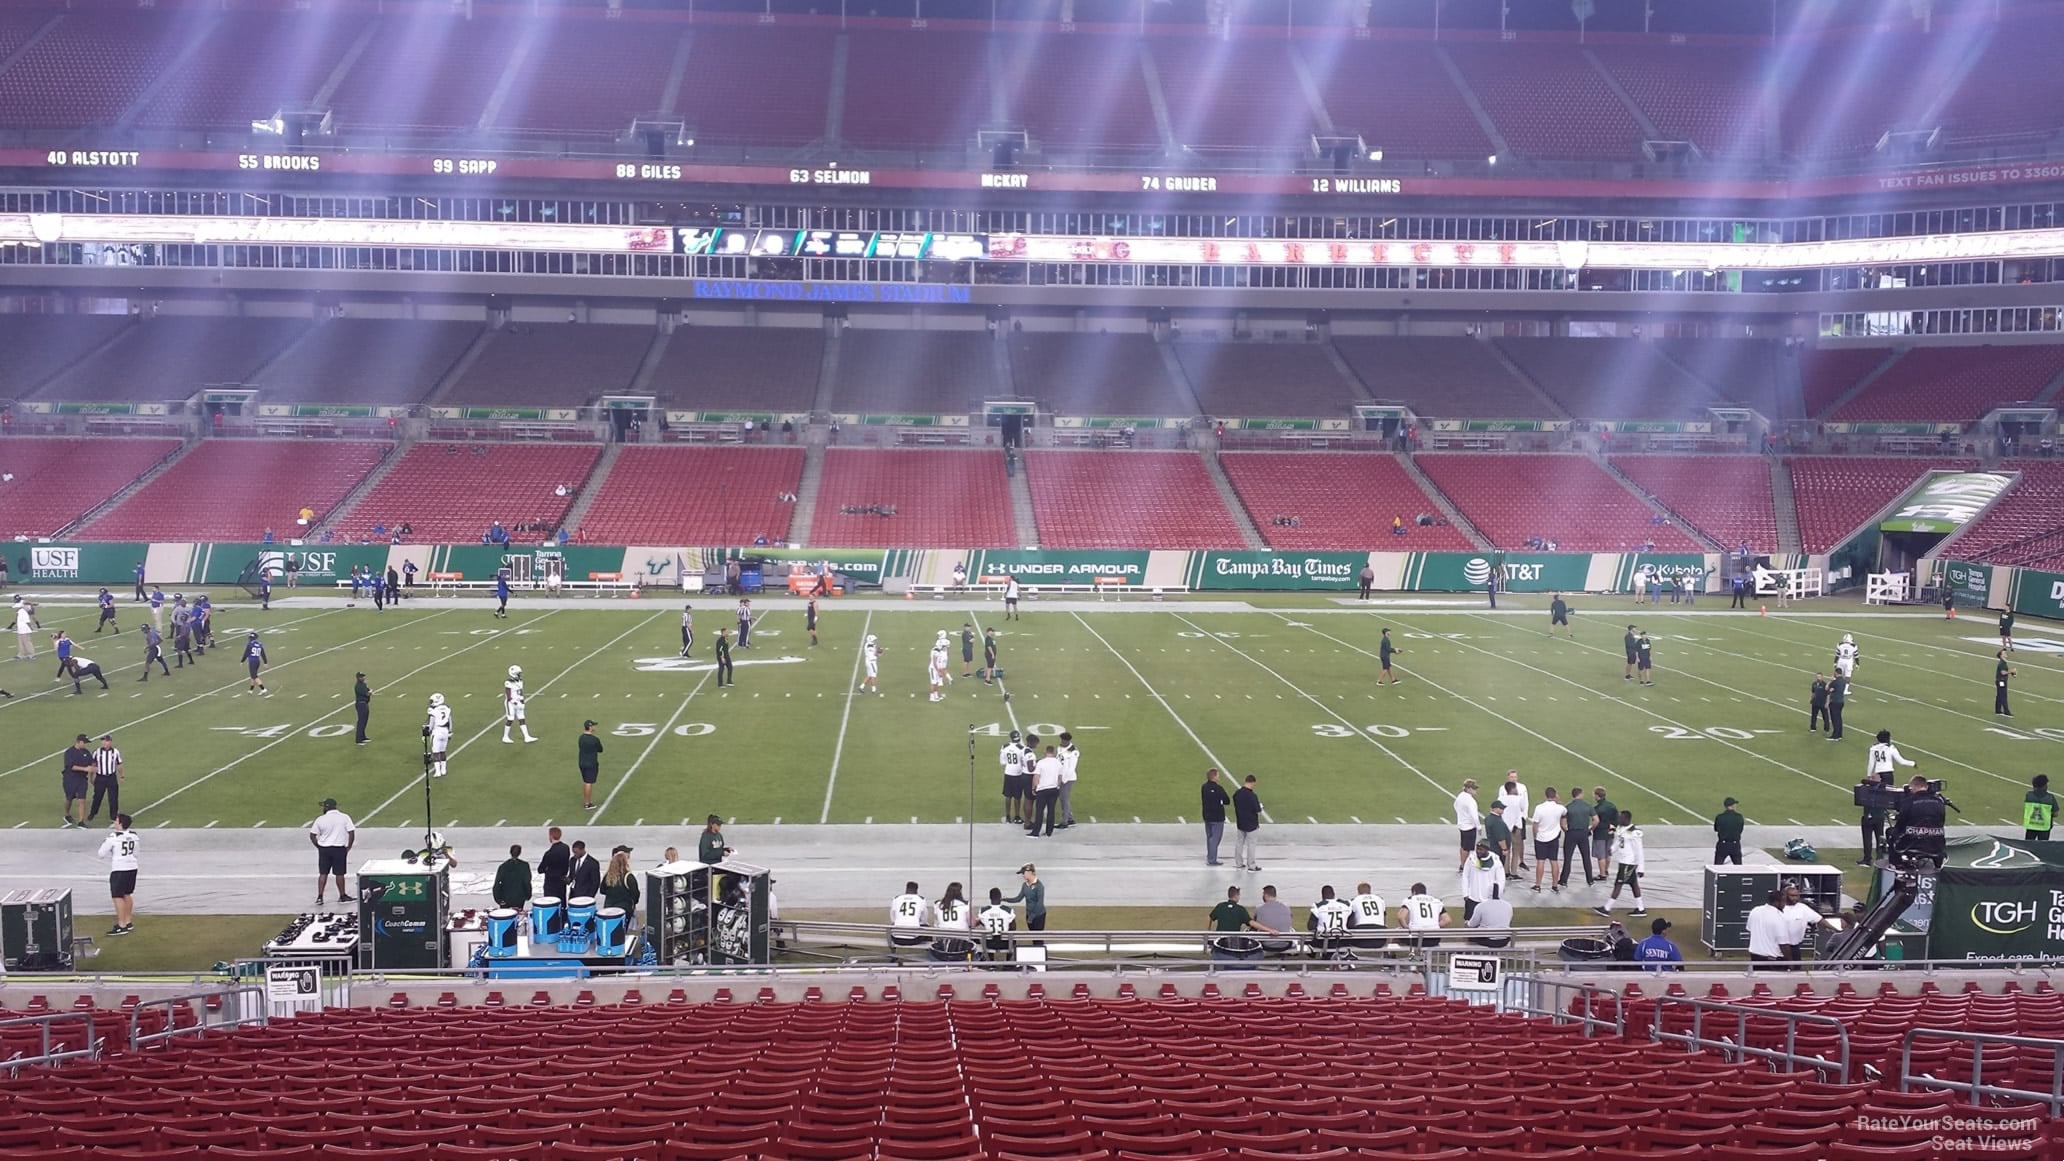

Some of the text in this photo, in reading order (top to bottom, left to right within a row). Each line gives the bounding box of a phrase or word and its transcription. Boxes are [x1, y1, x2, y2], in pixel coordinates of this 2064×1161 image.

[47, 151, 140, 166] 40 ALSTOTT
[239, 155, 320, 170] 55 BROOKS
[433, 159, 497, 174] 99 SAPP
[616, 164, 682, 179] 88 GILES
[789, 169, 870, 184] 63 SELMON
[1142, 176, 1217, 191] 74 GRUBER
[1879, 176, 1913, 189] TEXT
[1917, 175, 1944, 186] FAN
[1950, 171, 1997, 184] ISSUES
[2001, 169, 2020, 180] TO
[1312, 178, 1401, 193] 12 WILLIAMS
[694, 280, 971, 303] RAYMOND JAMES STADIUM
[36, 551, 76, 567] USF
[286, 552, 337, 572] USF
[32, 569, 79, 578] HEALTH
[1009, 564, 1064, 574] UNDER
[1216, 558, 1351, 579] Tampa Bay Times
[1501, 563, 1544, 581] AT&T
[1658, 563, 1703, 576] Kubota
[1951, 569, 1967, 581] TGH
[1311, 575, 1351, 583] tampabay.com
[250, 646, 262, 657] 90
[240, 723, 354, 738] 40
[611, 722, 717, 737] 50
[968, 723, 1067, 736] 40
[1311, 724, 1411, 738] 30
[1648, 725, 1755, 740] 20
[1006, 753, 1018, 765] 88
[1874, 751, 1887, 763] 84
[1906, 827, 1945, 836] CHAPMAN
[121, 840, 135, 857] 59
[2050, 889, 2064, 906] Ta
[899, 901, 917, 916] 45
[1362, 900, 1380, 916] 69
[1420, 902, 1433, 918] 61
[1980, 900, 2038, 924] TGH
[384, 920, 426, 928] CoachComm
[988, 918, 1004, 934] 33
[1328, 911, 1343, 929] 75
[1645, 949, 1669, 960] SENTRY
[1966, 951, 2005, 966] Expert
[1455, 960, 1482, 968] WARNING
